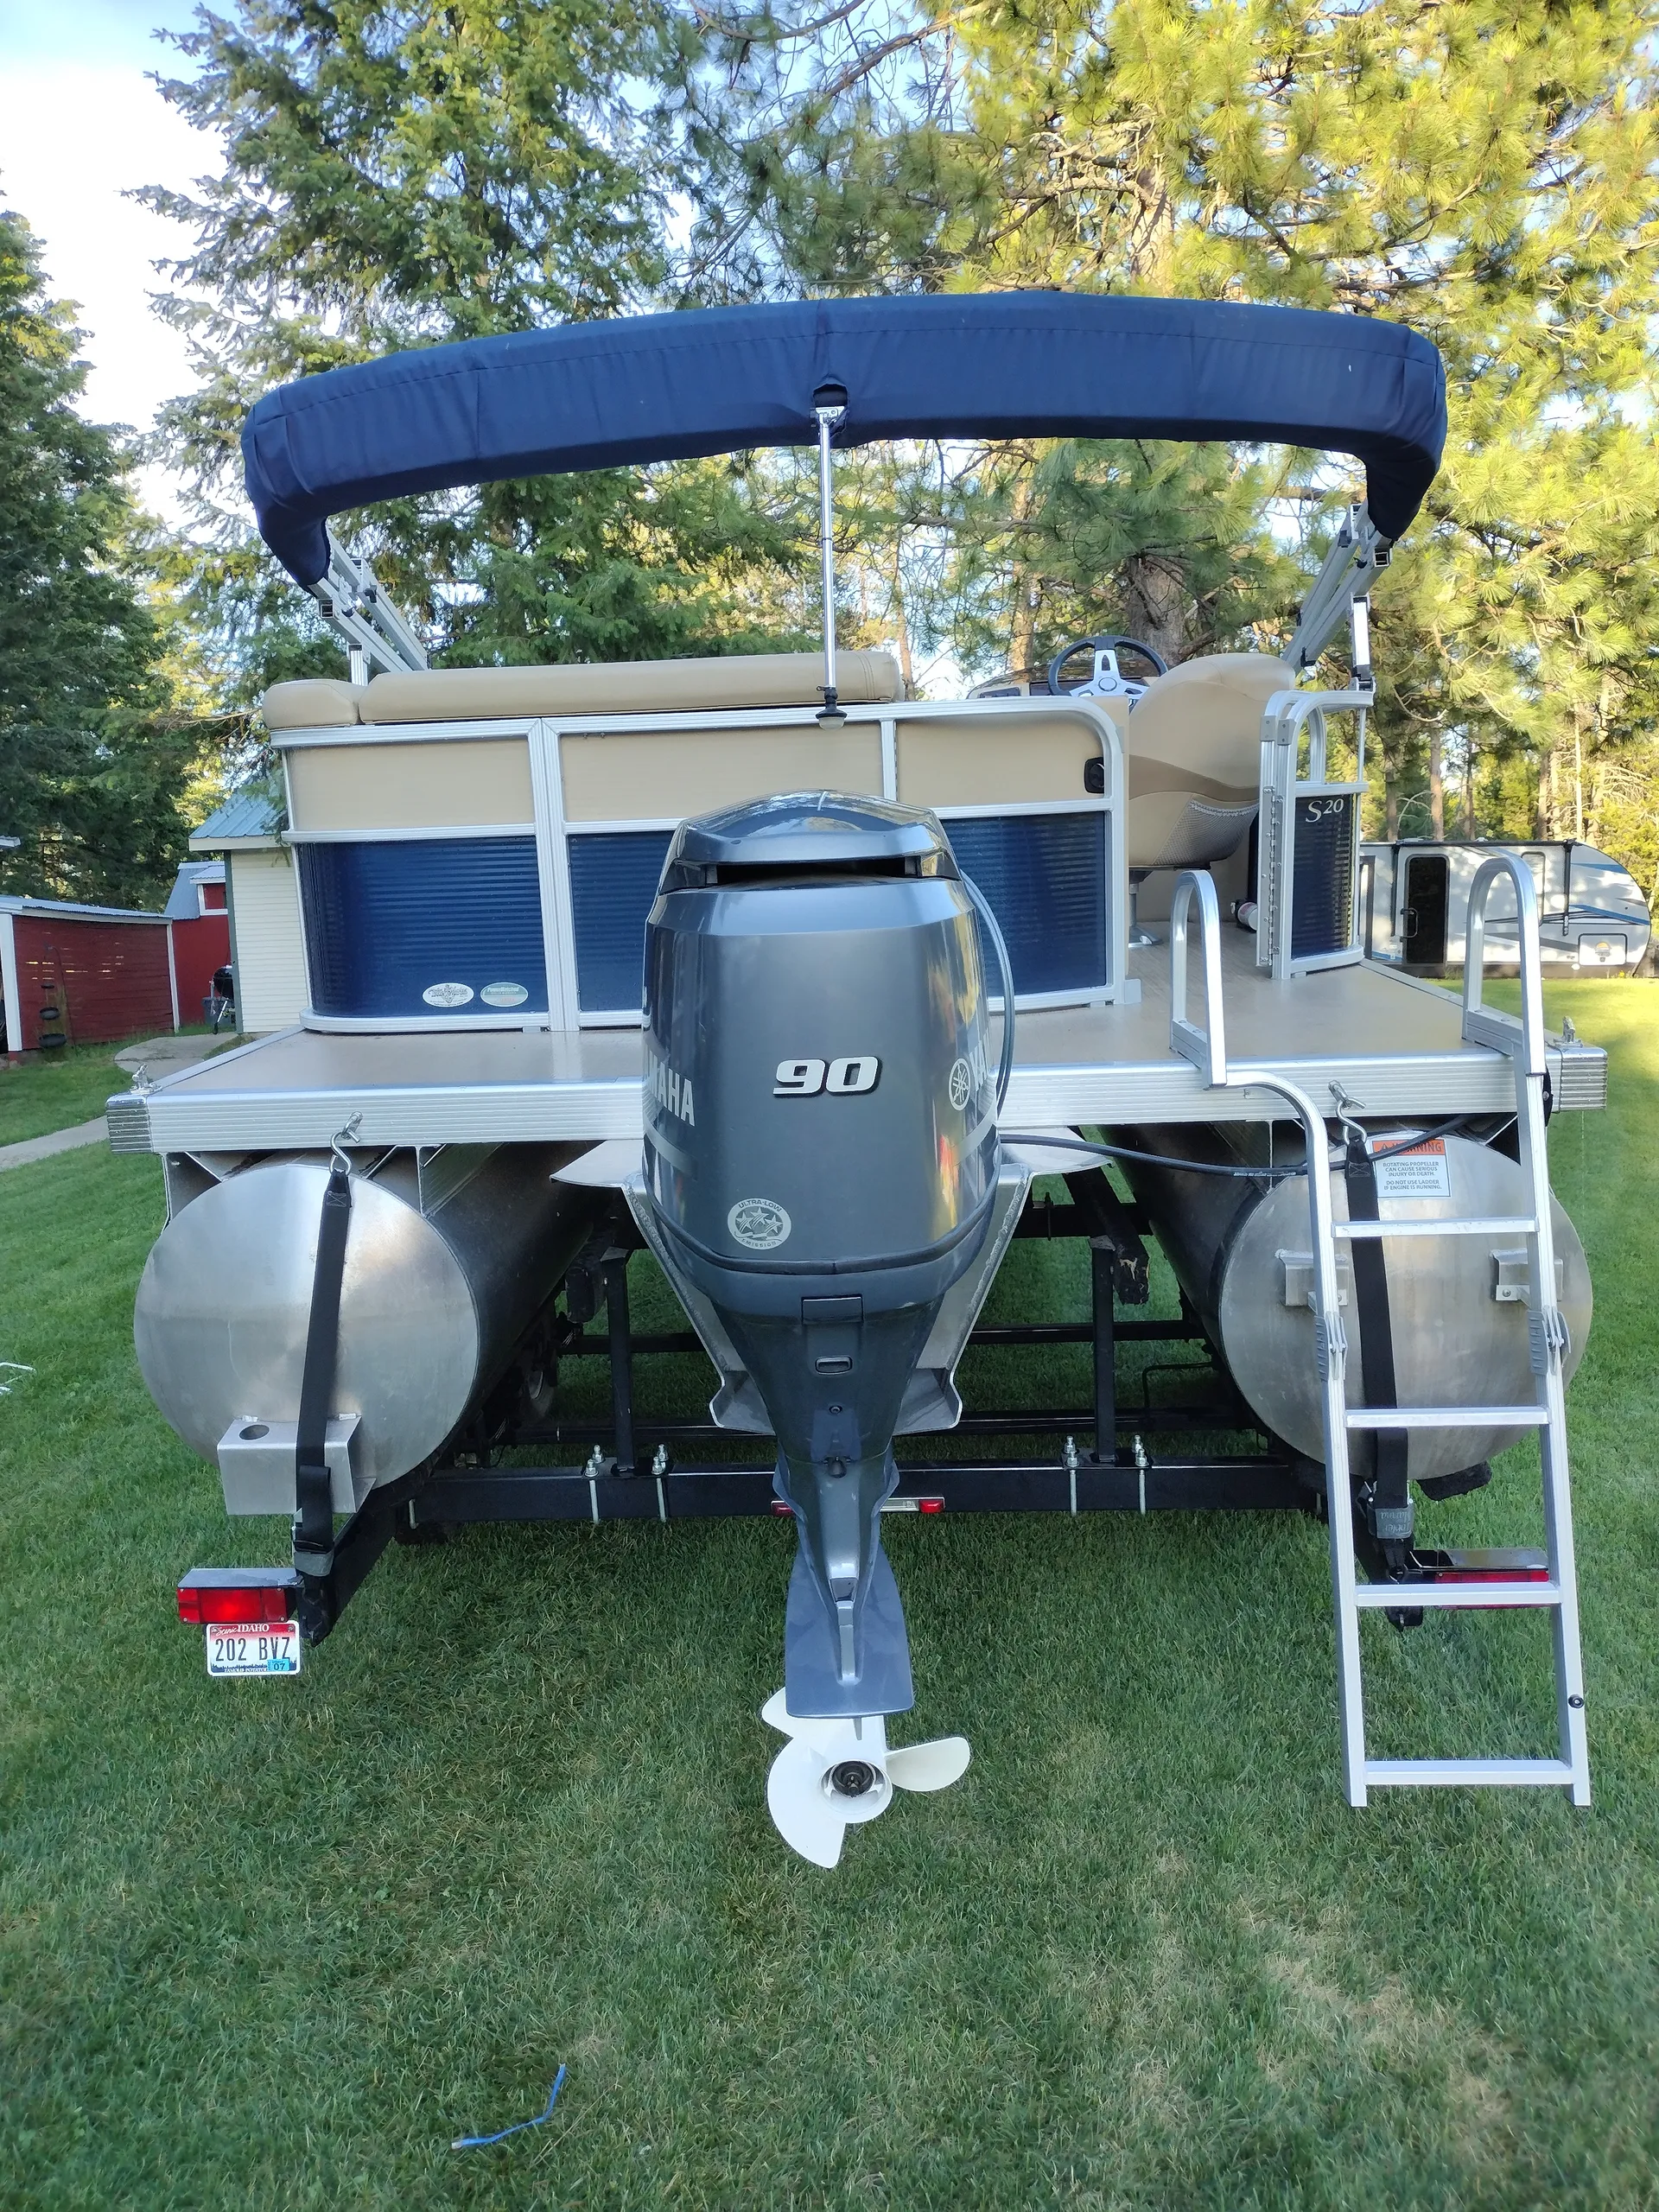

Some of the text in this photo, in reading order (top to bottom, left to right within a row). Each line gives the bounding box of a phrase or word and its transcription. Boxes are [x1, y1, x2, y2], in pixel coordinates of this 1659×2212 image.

[772, 1055, 880, 1096] 90
[237, 1624, 270, 1632] IDAHO
[215, 1637, 290, 1662] 202 BVZ
[273, 1662, 286, 1671] 07
